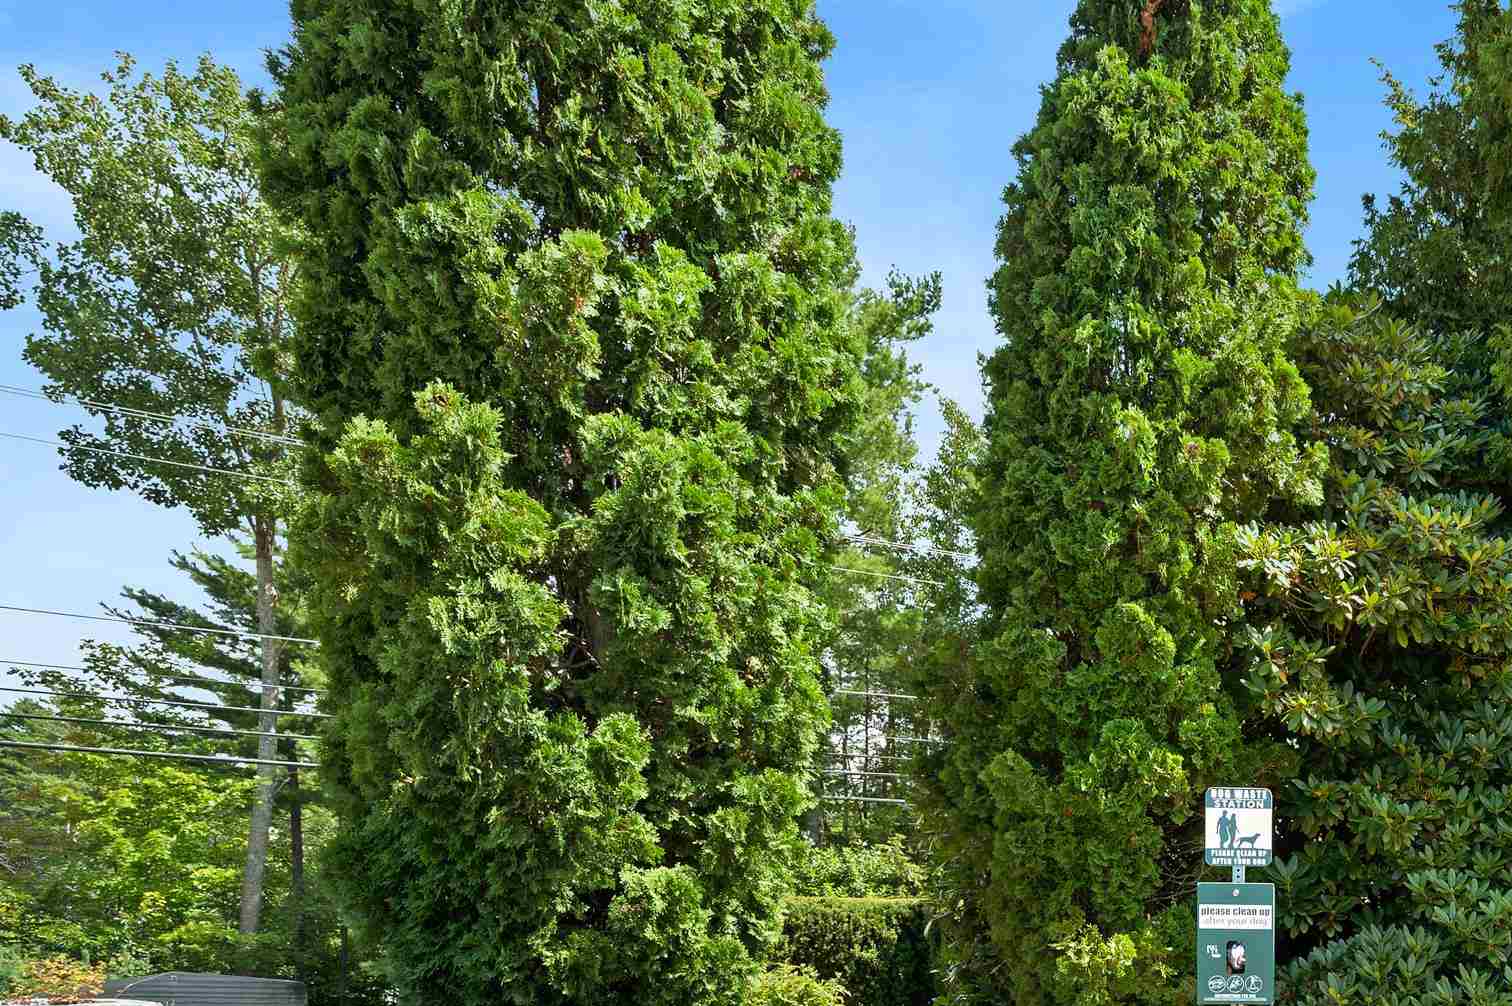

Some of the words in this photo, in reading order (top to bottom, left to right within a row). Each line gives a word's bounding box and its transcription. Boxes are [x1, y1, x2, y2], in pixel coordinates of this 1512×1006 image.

[1233, 789, 1267, 799] WASTE
[1214, 800, 1264, 808] STATION
[1201, 907, 1231, 917] please
[1232, 907, 1257, 916] clean
[1259, 908, 1270, 917] up
